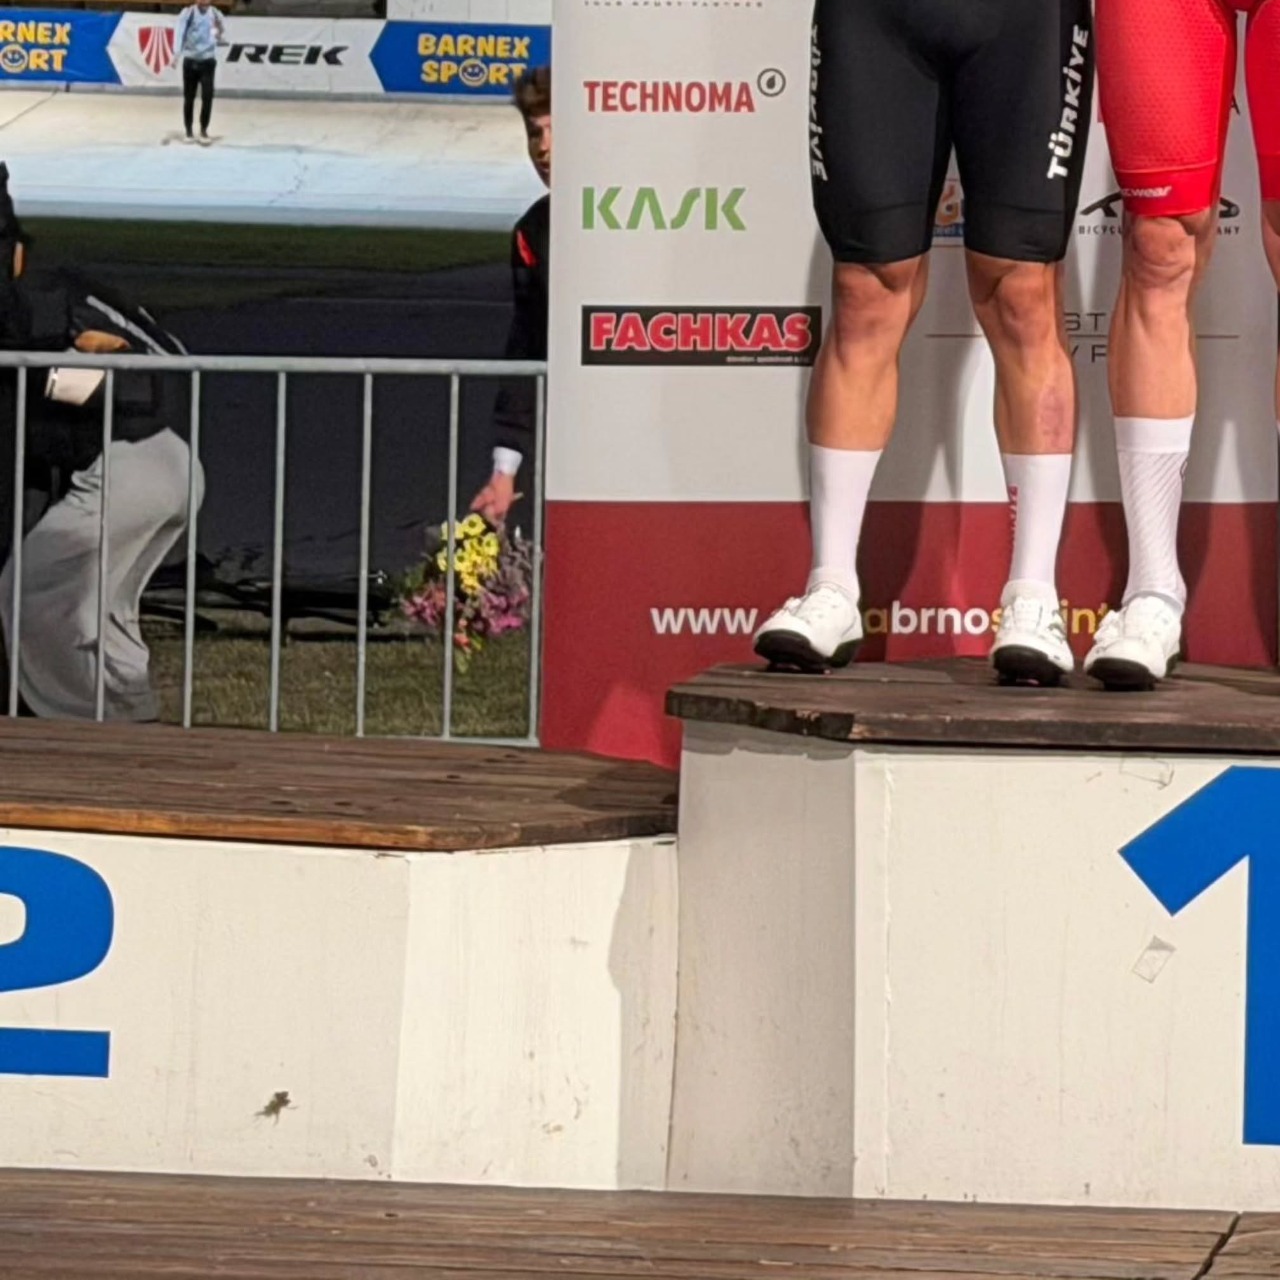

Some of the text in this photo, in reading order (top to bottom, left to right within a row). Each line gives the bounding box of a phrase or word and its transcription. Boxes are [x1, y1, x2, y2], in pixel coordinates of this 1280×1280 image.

[0, 20, 71, 45] RNEX
[418, 33, 530, 58] BARNEX
[421, 59, 527, 87] SPORT
[584, 81, 756, 112] TECHNOMA
[1047, 25, 1089, 180] TÜRKİYE
[582, 187, 747, 230] KASK
[590, 312, 812, 352] FACHKAS
